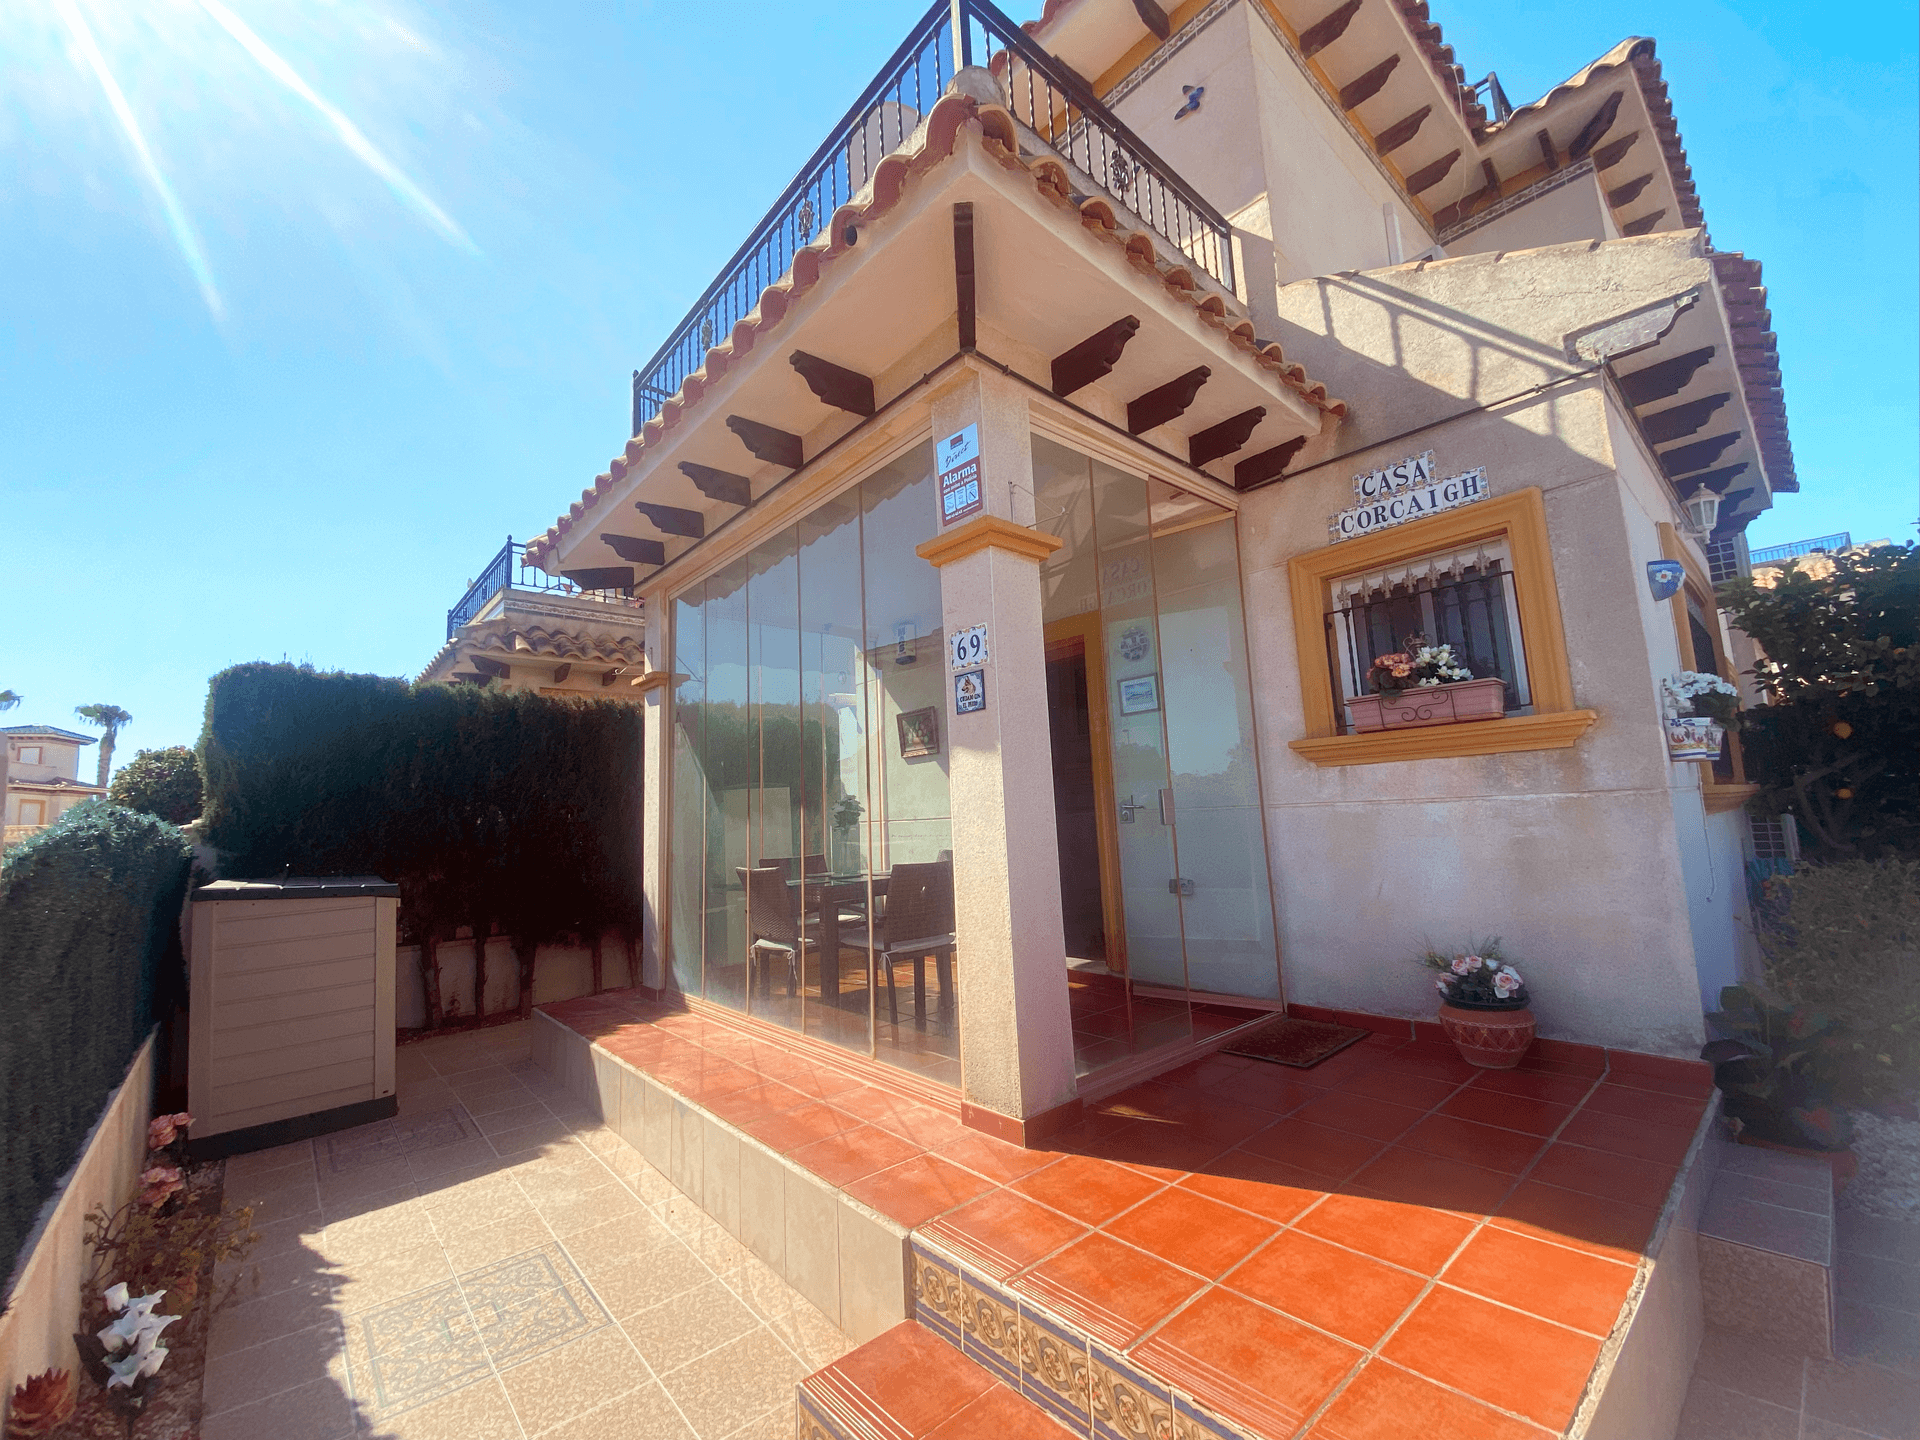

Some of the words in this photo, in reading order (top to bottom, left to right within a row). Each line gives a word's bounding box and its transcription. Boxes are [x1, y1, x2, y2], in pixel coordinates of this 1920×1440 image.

[943, 463, 977, 488] Alarma
[1361, 460, 1428, 497] CASA
[1340, 474, 1480, 534] CORCAIGH
[957, 634, 980, 660] 69
